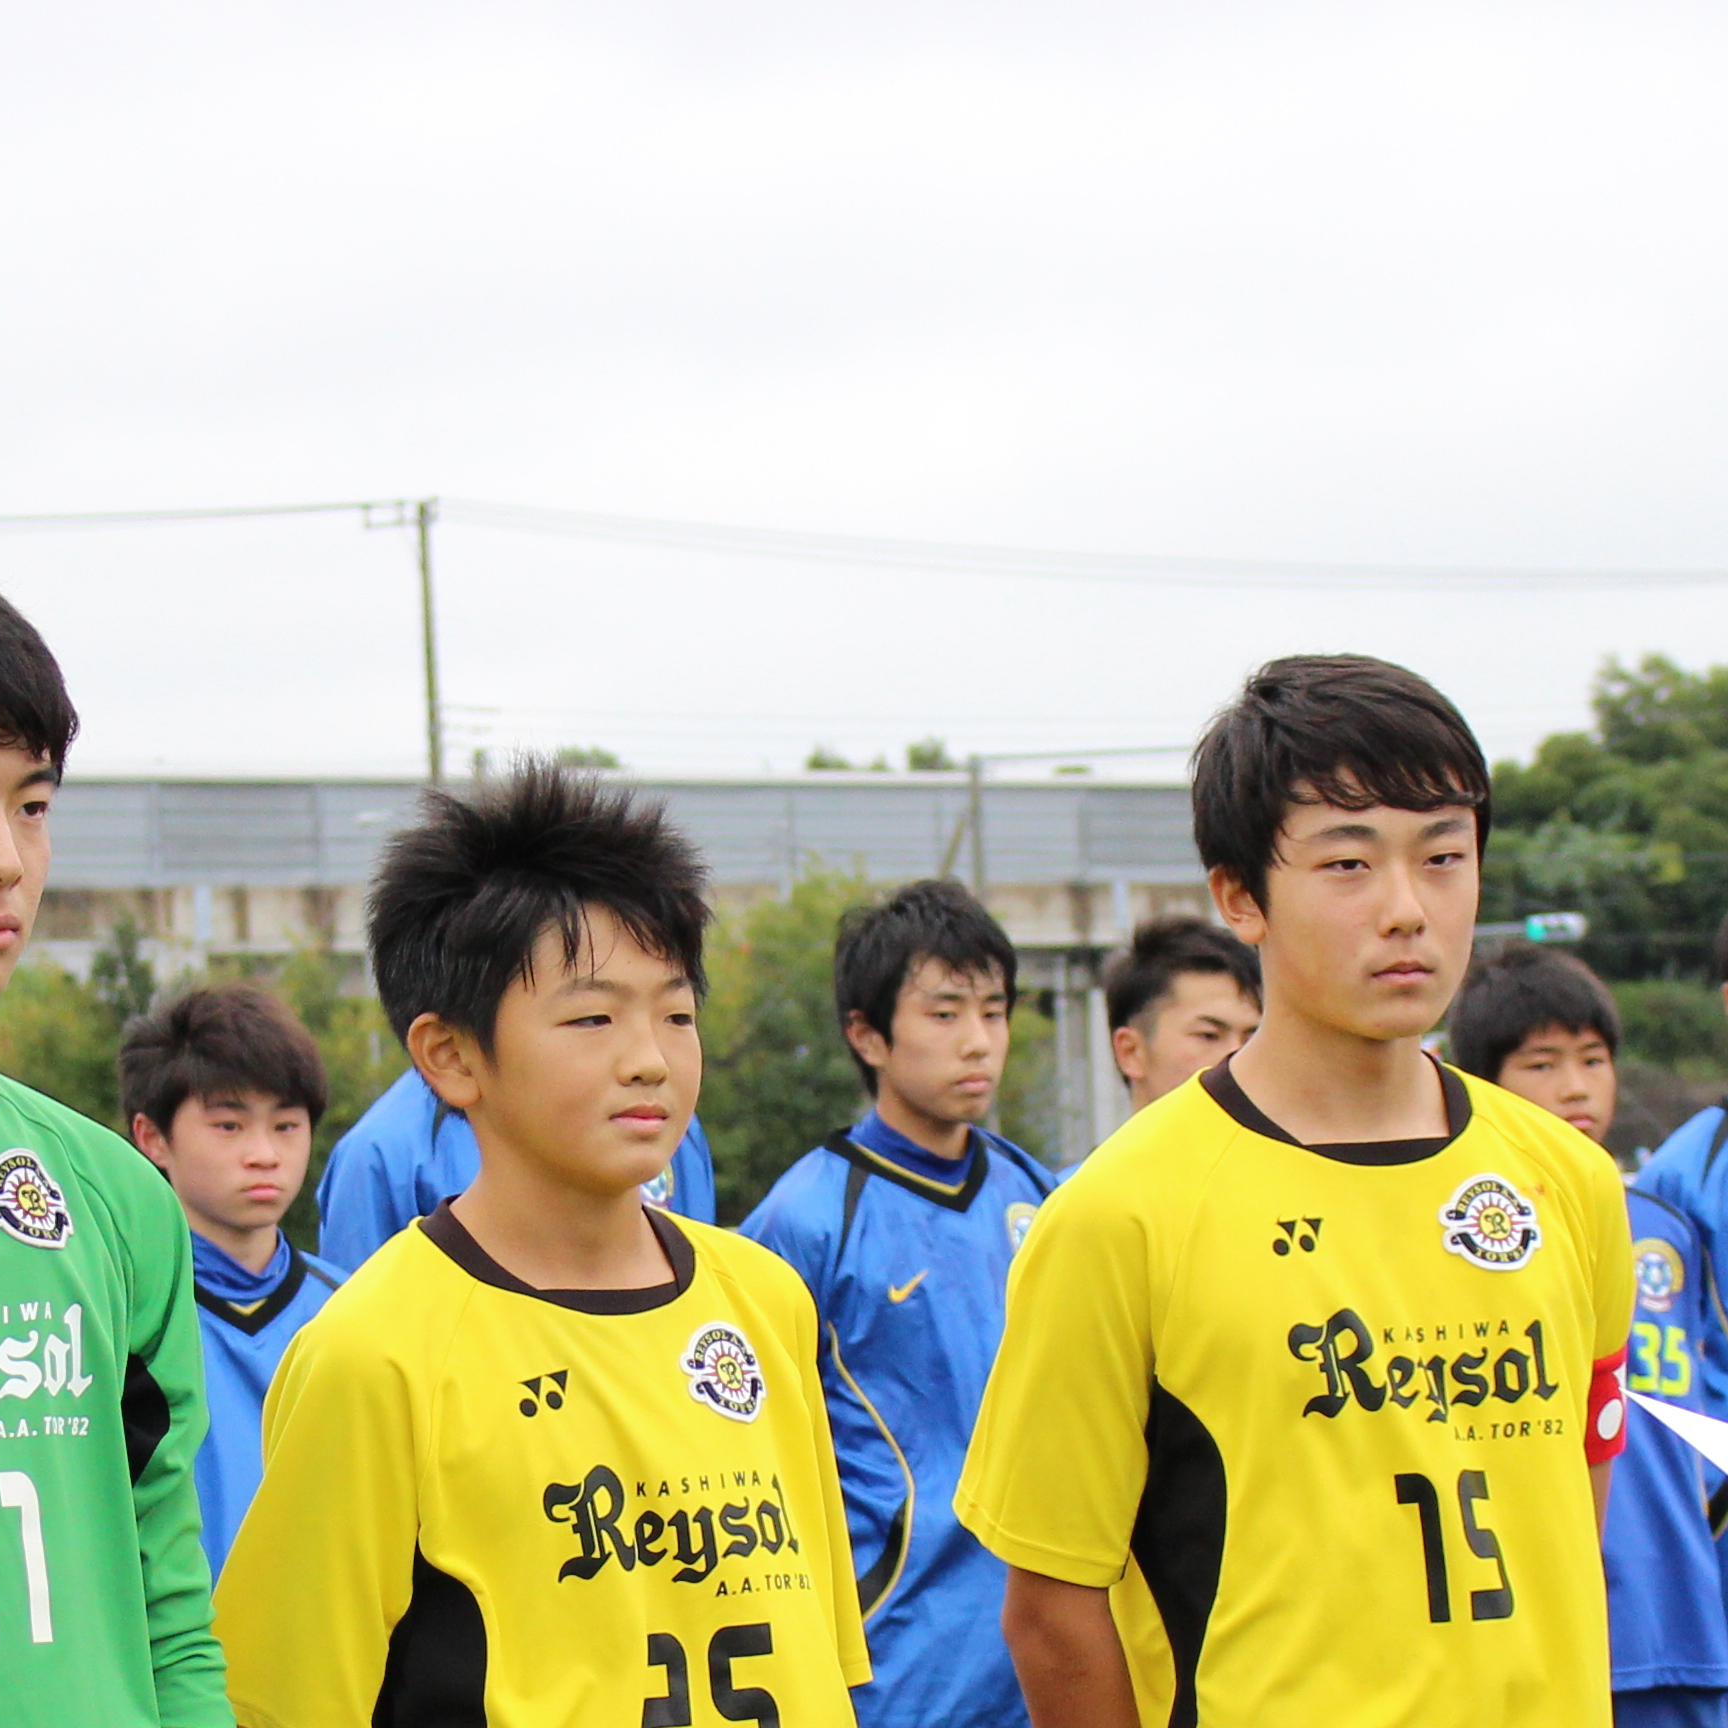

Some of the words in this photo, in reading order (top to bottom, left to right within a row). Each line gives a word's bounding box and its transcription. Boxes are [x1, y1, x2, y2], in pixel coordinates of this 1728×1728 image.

[1457, 1181, 1500, 1212] REYSOL
[695, 1330, 729, 1361] REYSOL
[1383, 1320, 1509, 1345] KASHIWA
[1288, 1308, 1559, 1424] Reysol
[1628, 1322, 1692, 1397] 35
[635, 1470, 762, 1499] KASHIWA
[543, 1465, 800, 1584] Reysol
[1394, 1468, 1516, 1624] 15
